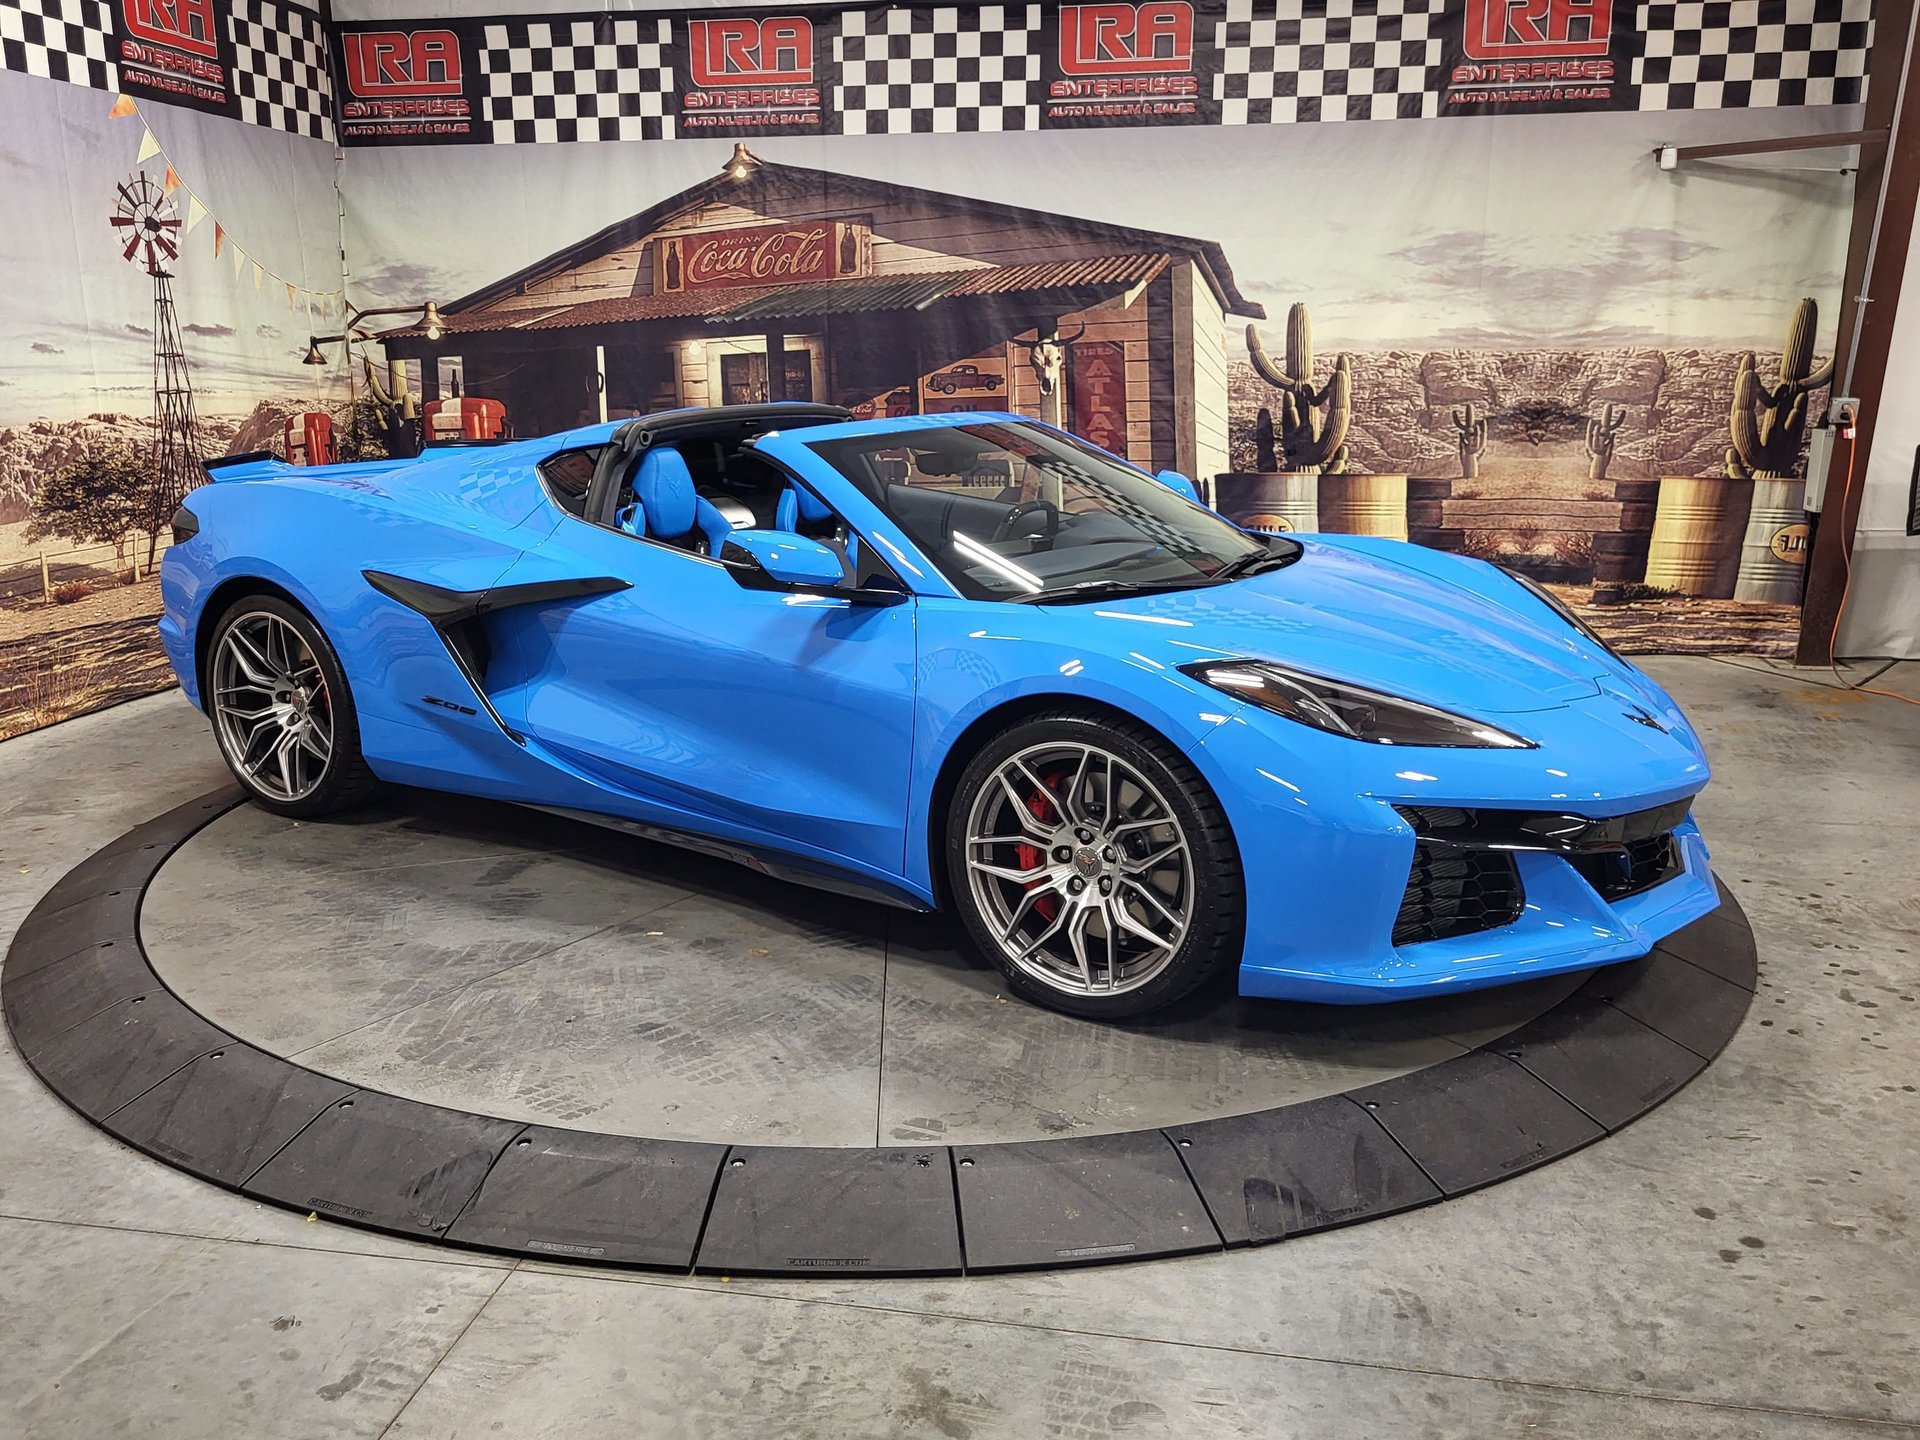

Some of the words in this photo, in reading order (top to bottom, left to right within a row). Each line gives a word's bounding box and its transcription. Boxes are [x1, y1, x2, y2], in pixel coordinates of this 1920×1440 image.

[121, 40, 224, 83] ENTERPRISES
[1451, 60, 1615, 83] ENTERPRISES
[1050, 76, 1198, 97] ENTERPRISES
[684, 88, 819, 108] ENTERPRISES
[1448, 92, 1488, 104] AUTO
[1489, 90, 1550, 102] MUSEUM
[1564, 88, 1611, 100] SALES
[343, 99, 470, 117] ENTERPRISES
[1048, 106, 1084, 117] AUTO
[1085, 104, 1141, 116] MUSEUM
[1153, 103, 1196, 114] SALES
[684, 116, 716, 127] AUTO
[718, 115, 769, 126] MUSEUM
[780, 113, 819, 124] SALES
[344, 126, 375, 136] AUTO
[376, 124, 424, 135] MUSEUM
[434, 123, 470, 133] SALES
[721, 235, 762, 246] DRINK
[686, 228, 830, 284] Coca-Cola
[1074, 348, 1114, 356] TIRES
[1086, 359, 1114, 448] ATLAS
